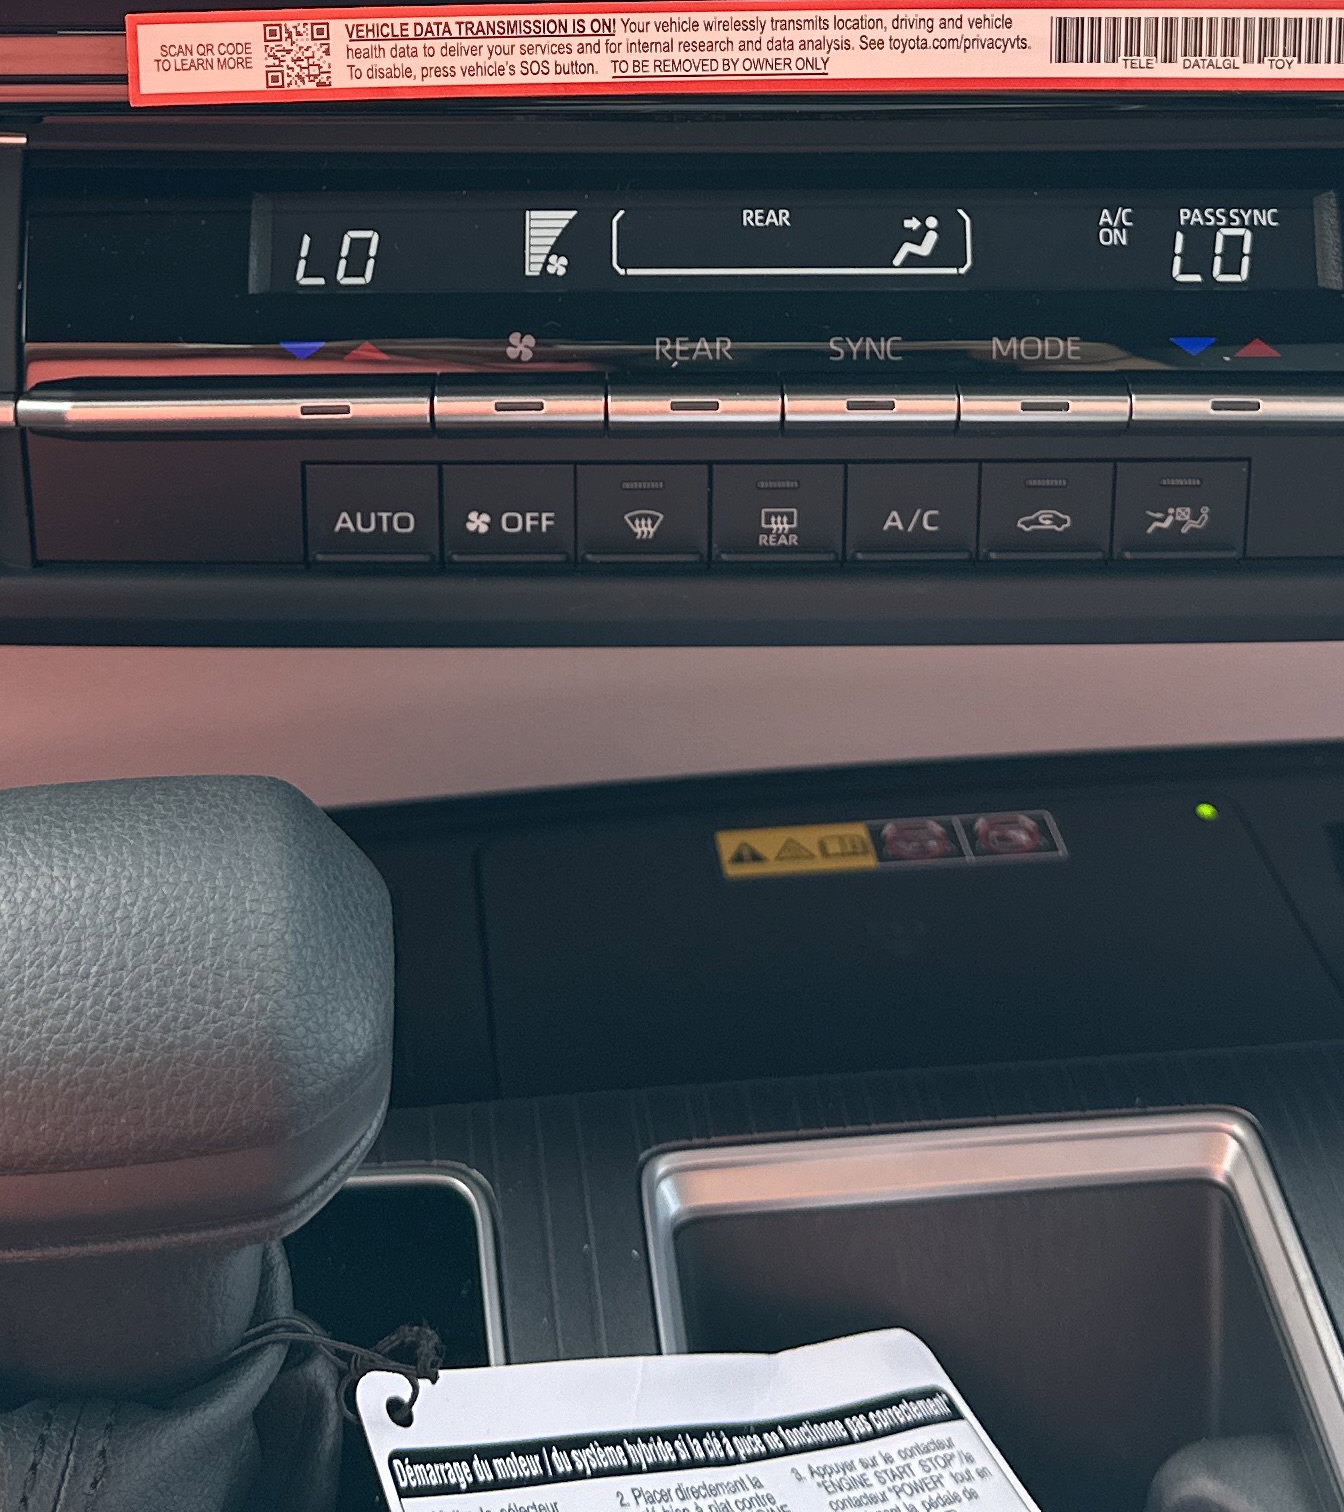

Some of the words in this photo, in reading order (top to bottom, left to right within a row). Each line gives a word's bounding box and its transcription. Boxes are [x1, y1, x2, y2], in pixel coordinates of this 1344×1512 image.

[345, 23, 409, 39] VEHICLE
[413, 22, 452, 37] DATA
[455, 19, 568, 37] TRANSMISSION
[572, 19, 586, 34] IS
[590, 18, 616, 34] ON!
[621, 19, 651, 34] Your
[654, 17, 699, 33] vehicle
[703, 16, 767, 35] wirelessly
[770, 15, 830, 32] transmits
[833, 14, 888, 32] location,
[891, 14, 934, 33] driving
[938, 14, 963, 29] and
[967, 14, 1013, 30] vehicle
[160, 44, 193, 58] SCAN
[196, 43, 215, 57] QR
[218, 42, 253, 56] CODE
[346, 43, 386, 59] health
[390, 44, 418, 58] data
[423, 44, 435, 57] to
[440, 42, 483, 57] deliver
[487, 44, 516, 61] your
[519, 40, 572, 56] services
[576, 39, 601, 54] and
[605, 39, 622, 54] for
[626, 38, 674, 53] internal
[678, 37, 733, 52] research
[738, 36, 762, 52] and
[766, 36, 794, 51] data
[798, 35, 855, 54] analysis.
[858, 35, 885, 50] See
[154, 59, 171, 72] TO
[174, 58, 214, 71] LEARN
[217, 57, 253, 70] MORE
[347, 64, 362, 80] To
[366, 63, 417, 81] disable,
[421, 65, 456, 82] press
[460, 61, 516, 77] vehicle's
[520, 60, 550, 76] SOS
[554, 59, 599, 76] button.
[611, 60, 629, 74] TO
[632, 59, 649, 74] BE
[654, 58, 719, 73] REMOVED
[722, 58, 739, 72] BY
[742, 57, 792, 71] OWNER
[795, 57, 830, 71] ONLY
[1122, 58, 1154, 70] TELE
[1182, 58, 1240, 70] DATALGL
[1268, 58, 1295, 70] TOY
[742, 209, 791, 227] REAR
[1098, 207, 1134, 227] A/C
[1179, 208, 1227, 227] PASS
[1229, 208, 1279, 227] SYNC
[1099, 228, 1127, 246] ON
[655, 337, 733, 361] REAR
[828, 337, 903, 361] SYNC
[991, 337, 1081, 361] MODE
[334, 511, 416, 534] AUTO
[501, 511, 555, 533] OFF
[882, 509, 939, 533] A/C
[759, 533, 798, 546] REAR
[393, 1457, 474, 1491] Démarrage
[472, 1454, 494, 1483] du
[493, 1451, 543, 1480] moteur
[552, 1446, 572, 1473] du
[571, 1439, 627, 1477] système
[623, 1436, 677, 1471] hybride
[674, 1433, 691, 1461] si
[686, 1432, 705, 1460] la
[703, 1430, 725, 1458] clé
[732, 1432, 767, 1463] puce
[763, 1430, 785, 1451] ne
[778, 1417, 848, 1449] fonctionne
[844, 1413, 874, 1441] pas
[807, 1458, 857, 1482] Appuyer
[858, 1454, 880, 1470] sur
[878, 1449, 895, 1465] le
[897, 1436, 956, 1457] contacteur
[873, 1462, 917, 1485] START
[631, 1487, 674, 1506] Placer
[675, 1475, 750, 1502] directement
[745, 1473, 765, 1489] la
[828, 1489, 889, 1511] contacteur
[949, 1467, 977, 1485] tout
[976, 1465, 993, 1481] en
[962, 1486, 980, 1501] de
[734, 1492, 777, 1511] contre
